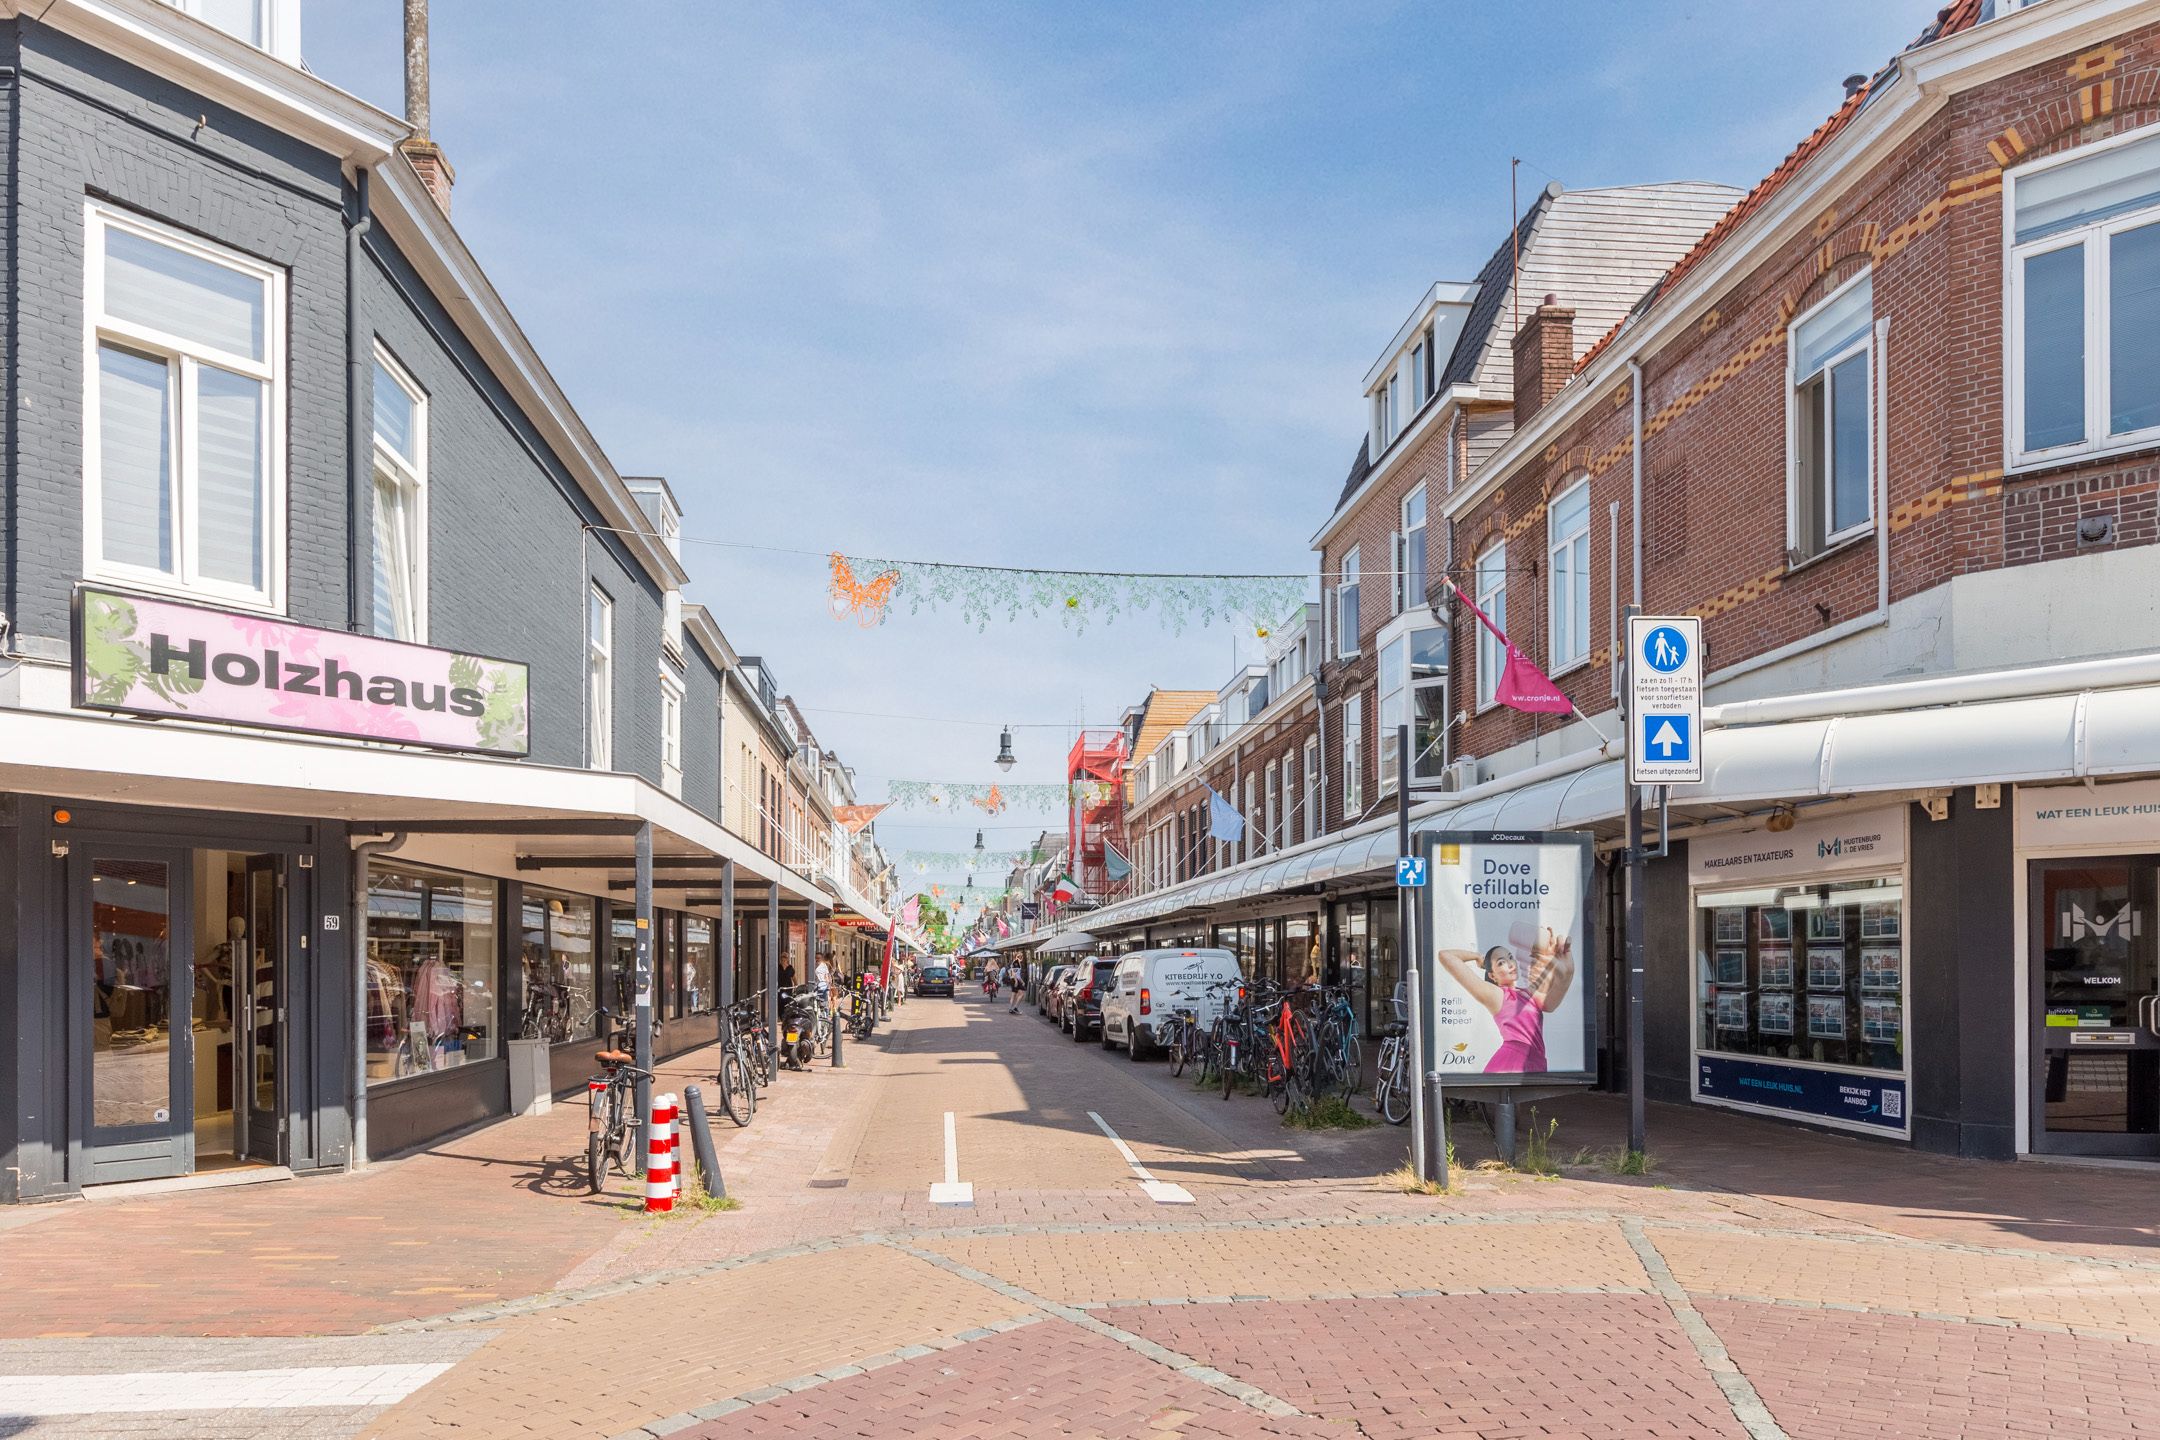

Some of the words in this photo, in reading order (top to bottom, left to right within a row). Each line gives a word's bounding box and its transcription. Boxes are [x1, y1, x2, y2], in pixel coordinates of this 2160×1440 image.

[150, 632, 486, 718] Holzhaus
[1661, 686, 1696, 694] toegestaan
[1659, 768, 1698, 776] uitgezonderd
[2036, 810, 2063, 819] WAT
[2066, 808, 2091, 818] EEN
[2095, 806, 2130, 816] LEUK
[1844, 834, 1881, 845] HUGTENBURG
[1849, 845, 1856, 853] DE
[1705, 854, 1742, 869] MAKELAARS
[1744, 854, 1752, 864] EN
[1753, 849, 1793, 862] TAXATEURS
[1484, 859, 1530, 875] Dove
[1464, 879, 1549, 895] refillable
[1473, 898, 1540, 909] deodorant
[326, 916, 338, 929] 59
[1442, 1007, 1468, 1015] Reuse
[1442, 1017, 1472, 1026] Repeat
[1442, 1051, 1475, 1064] Dove
[1739, 1077, 1751, 1087] WAT
[1751, 1079, 1763, 1088] EEN
[1763, 1080, 1778, 1090] LEUK
[1778, 1082, 1804, 1094] HUIS.NL
[1839, 1085, 1859, 1095] BEKIJK
[1860, 1089, 1871, 1097] HET
[1843, 1096, 1867, 1106] AANBOD
